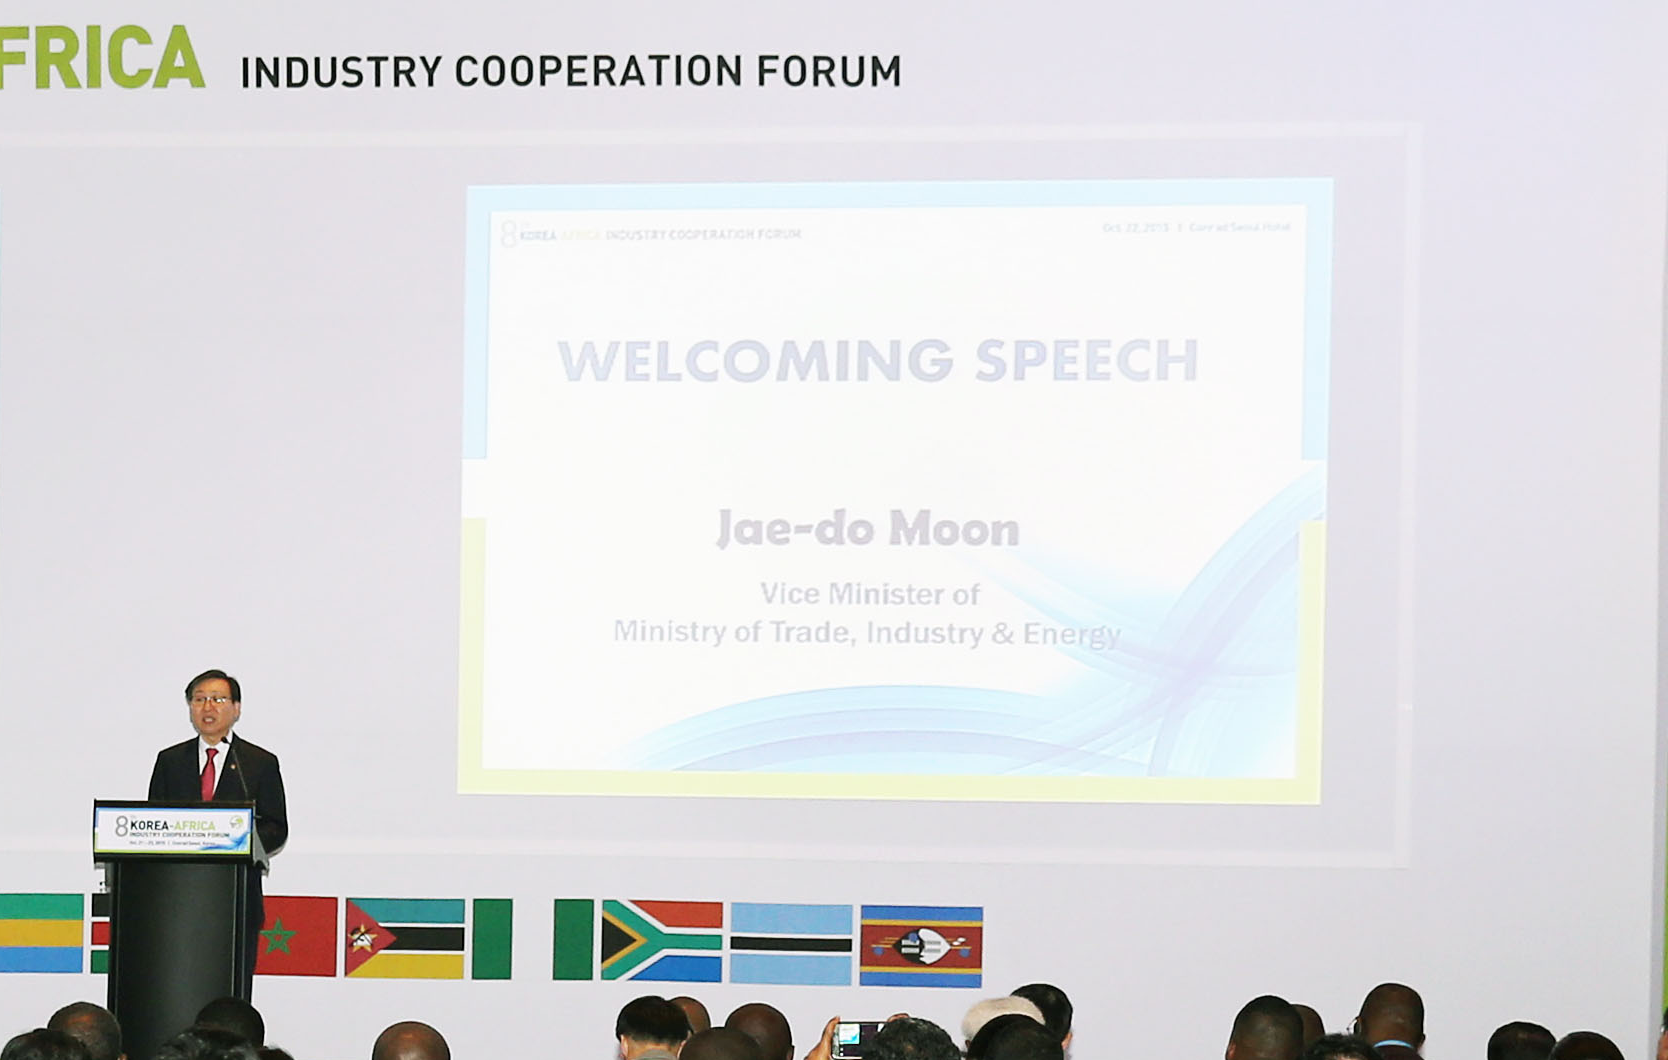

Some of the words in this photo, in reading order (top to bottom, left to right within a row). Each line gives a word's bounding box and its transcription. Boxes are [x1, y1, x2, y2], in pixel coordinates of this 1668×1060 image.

[241, 55, 443, 89] INDUSTRY
[455, 54, 741, 88] COOPERATION
[758, 54, 902, 88] FORUM
[557, 338, 955, 383] WELCOMING
[974, 337, 1199, 383] SPEECH
[715, 508, 876, 551] Jae-do
[889, 509, 1020, 547] Moon
[760, 581, 820, 606] Vice
[828, 581, 944, 606] Minister
[952, 581, 981, 606] of
[613, 619, 727, 648] Ministry
[734, 620, 763, 643] of
[772, 620, 857, 648] Trade,
[867, 620, 984, 650] Industry
[992, 621, 1014, 645] &
[1024, 622, 1122, 651] Energy
[115, 815, 128, 837] 8
